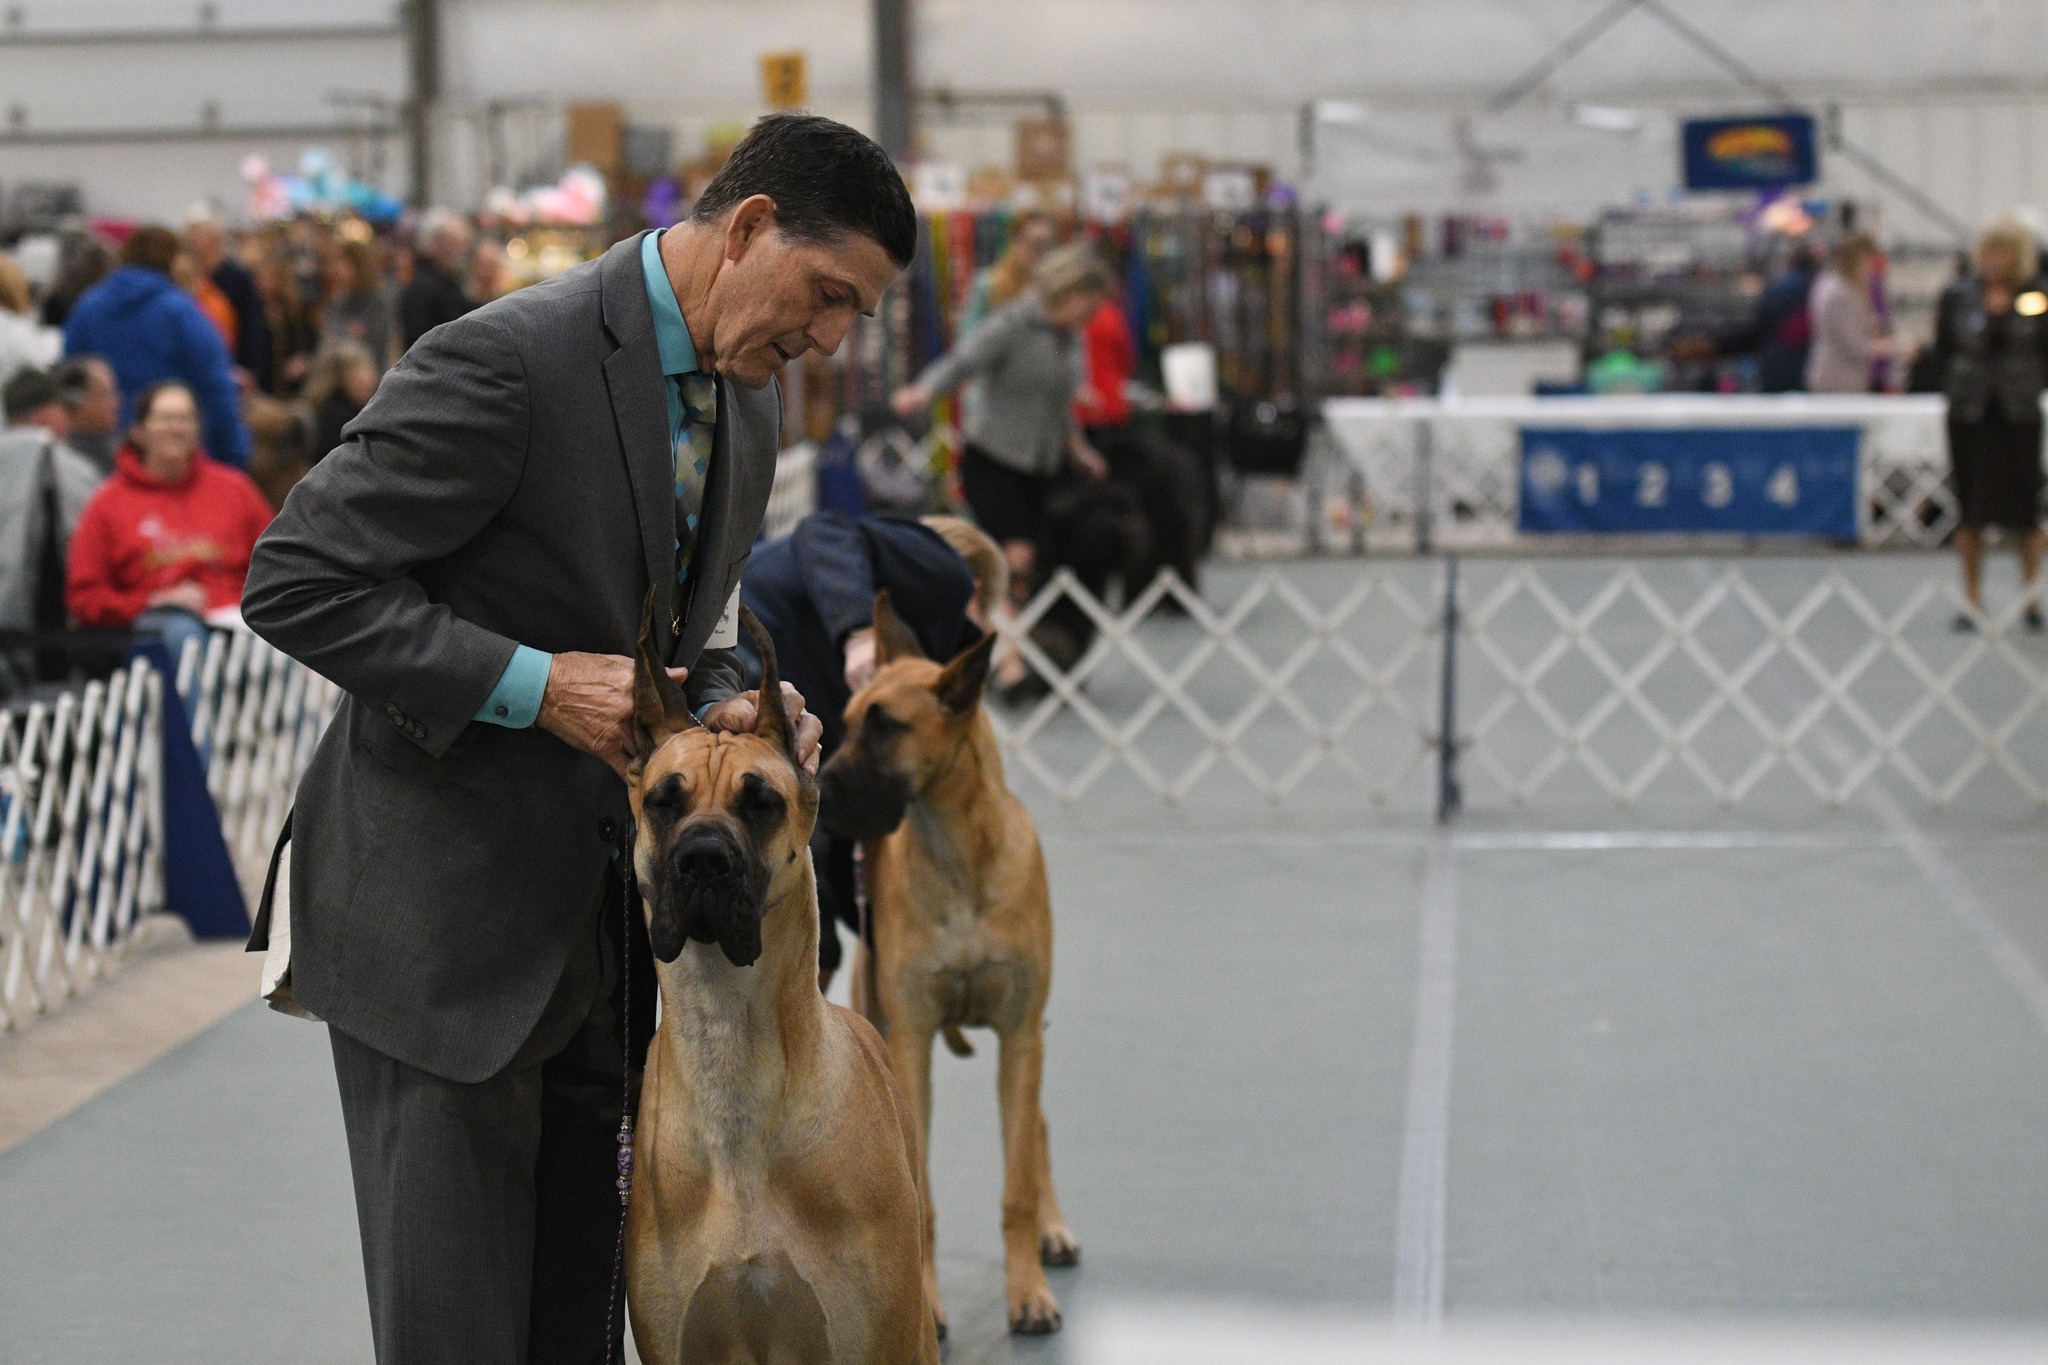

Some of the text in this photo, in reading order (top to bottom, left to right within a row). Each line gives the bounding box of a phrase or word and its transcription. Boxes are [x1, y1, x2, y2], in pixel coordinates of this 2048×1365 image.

[1577, 462, 1798, 508] 1 2 3 4
